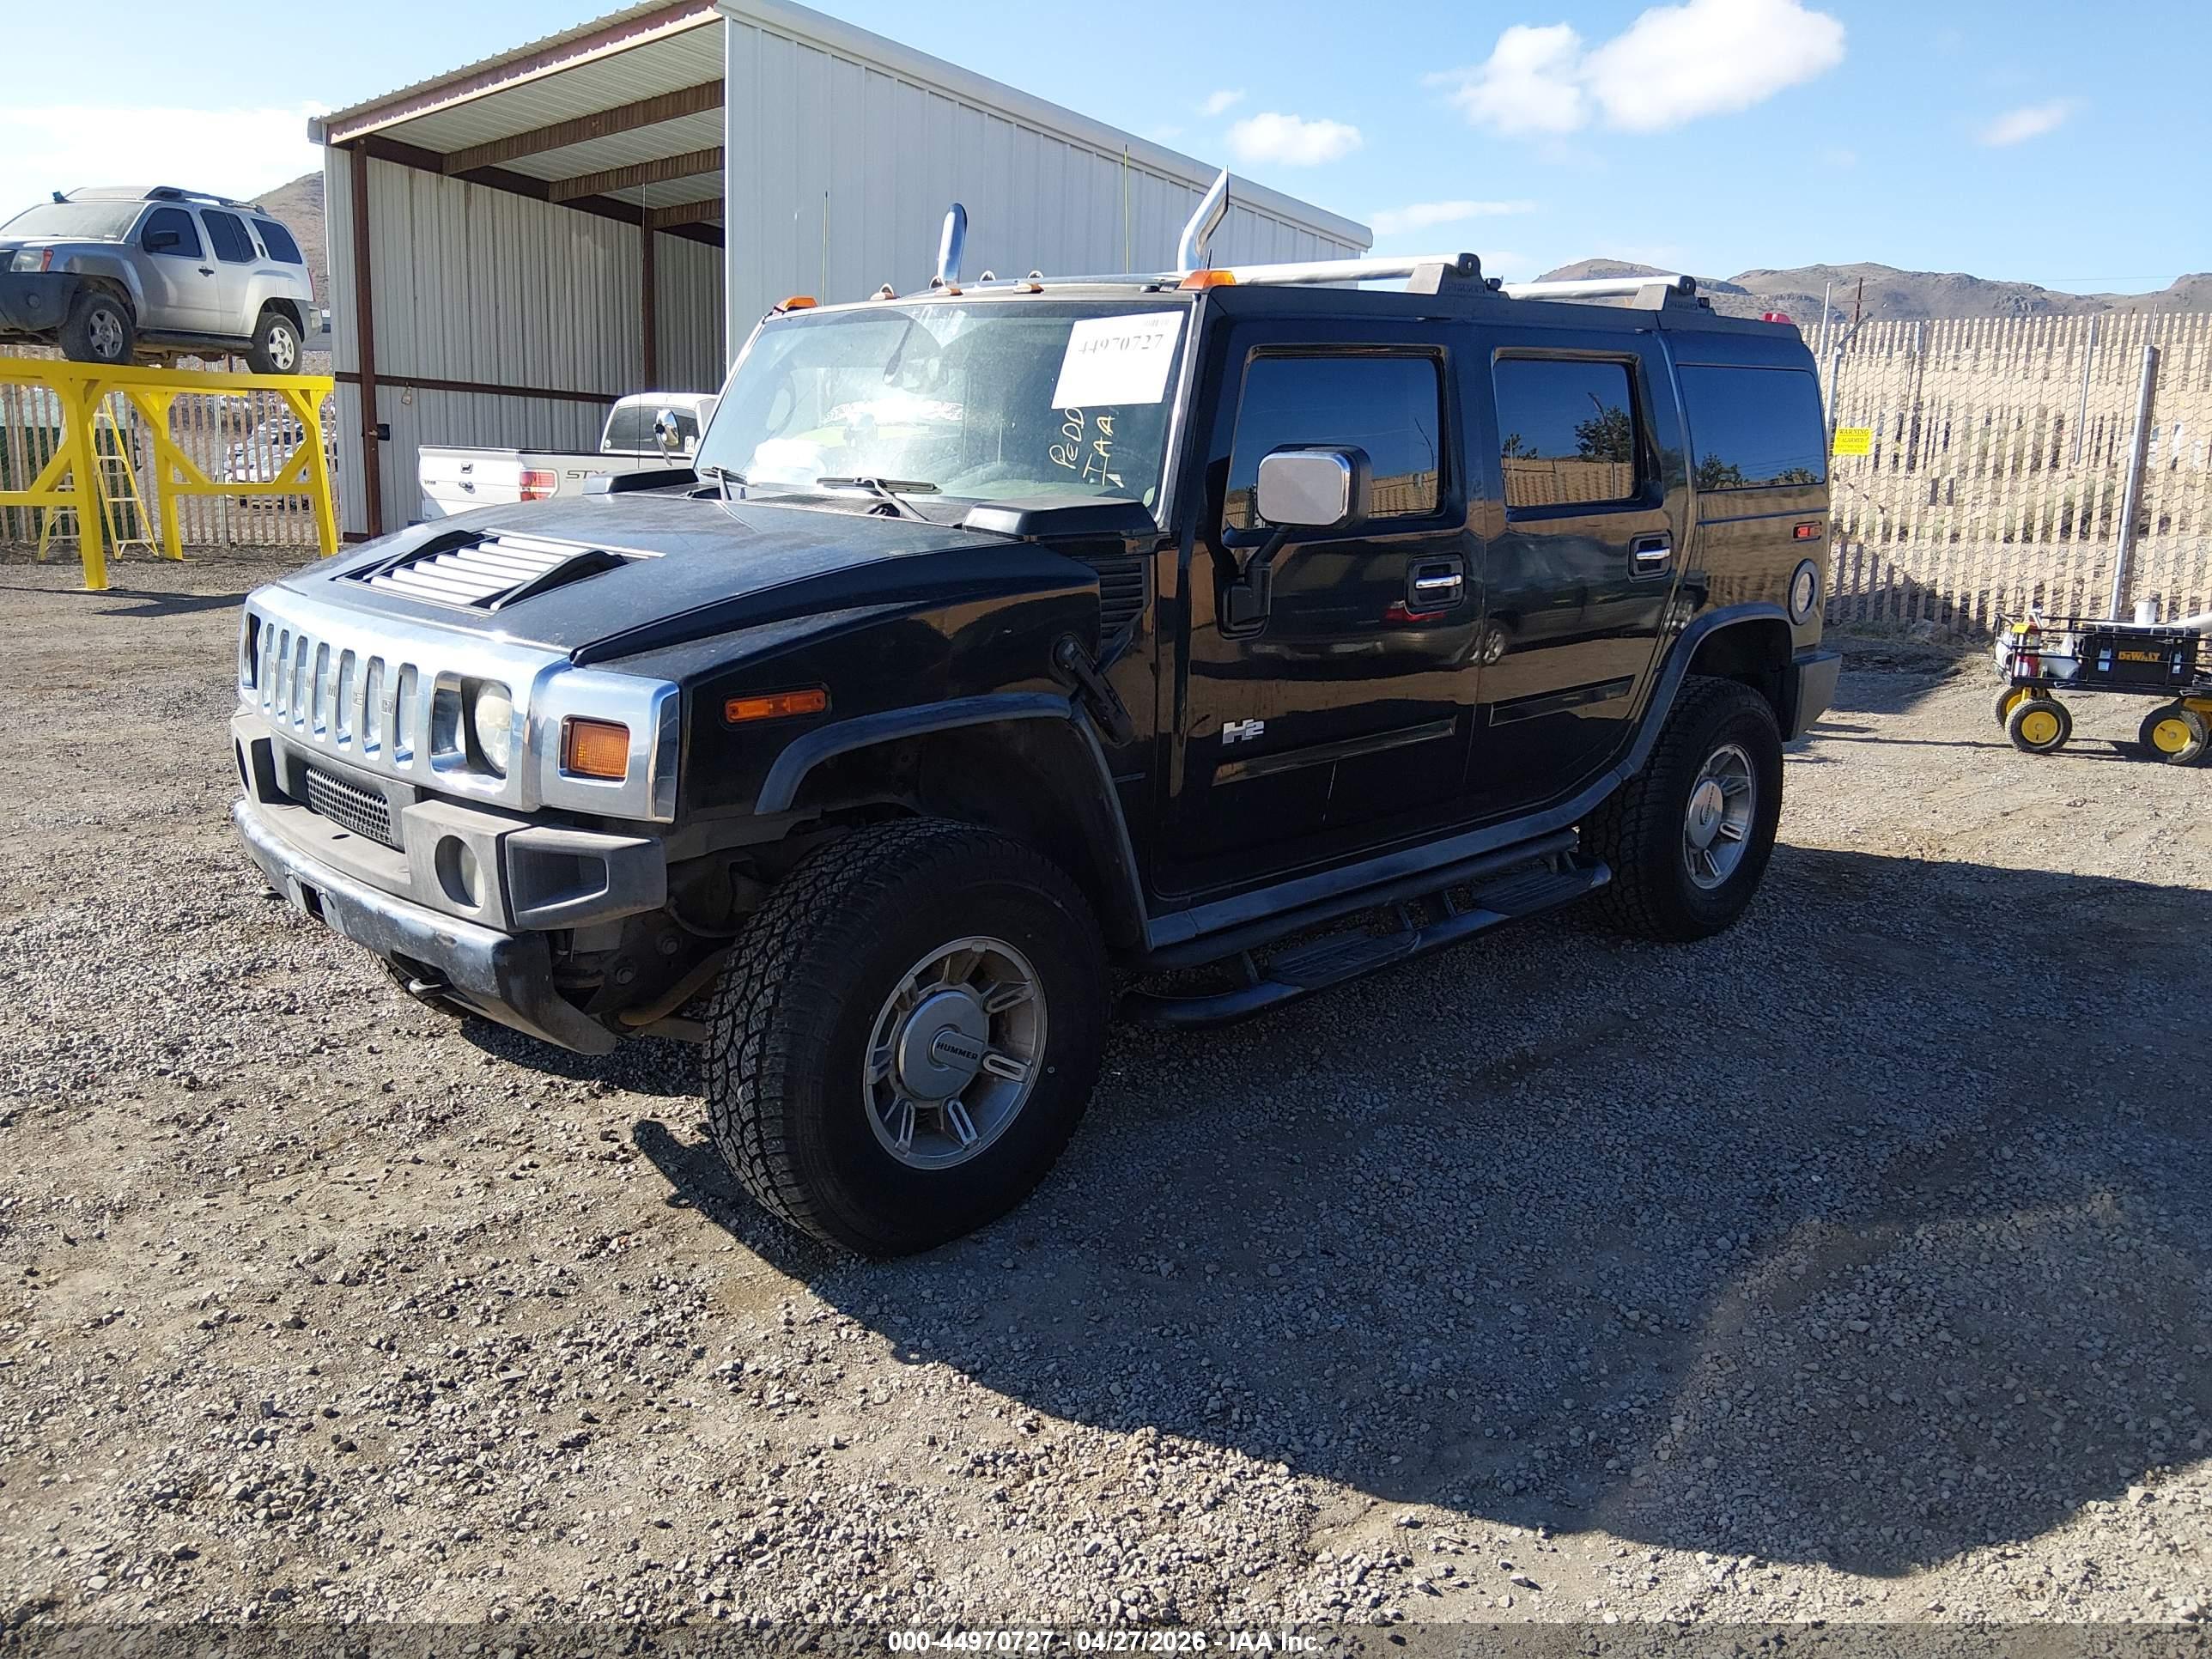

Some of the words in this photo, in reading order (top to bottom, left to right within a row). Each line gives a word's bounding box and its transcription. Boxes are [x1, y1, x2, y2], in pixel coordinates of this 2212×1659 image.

[1079, 333, 1164, 355] 44970727
[1222, 718, 1265, 744] H2
[936, 1041, 979, 1060] HUMMER
